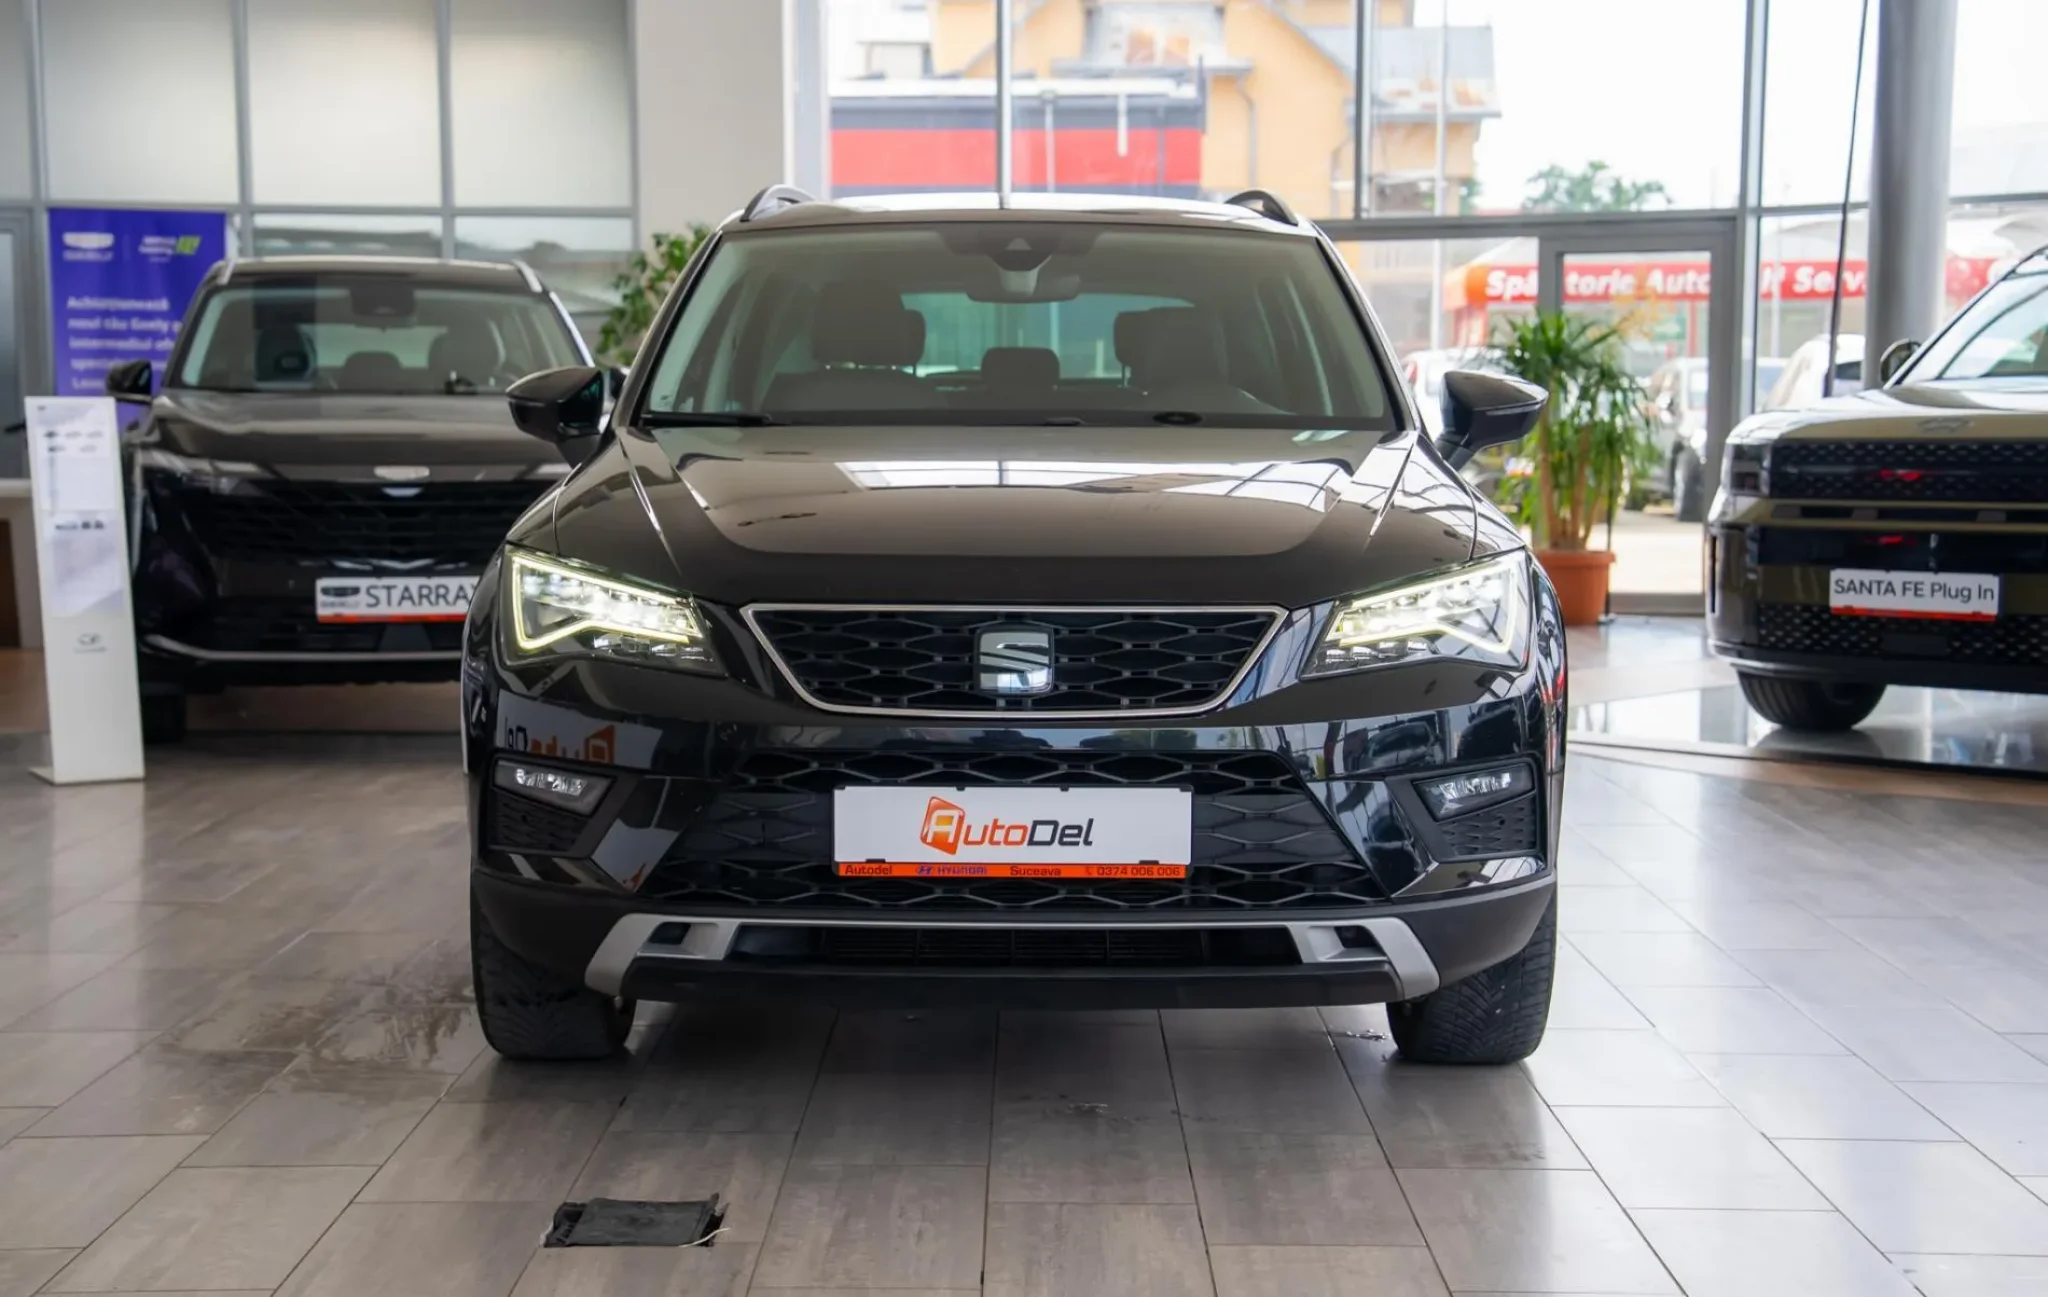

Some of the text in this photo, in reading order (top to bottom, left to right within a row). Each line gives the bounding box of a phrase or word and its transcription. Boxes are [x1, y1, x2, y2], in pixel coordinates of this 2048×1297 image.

[365, 583, 477, 608] STARRA
[1834, 578, 1995, 604] SANTA FE Plug In
[925, 806, 1095, 847] AutoDel
[844, 865, 893, 875] Autodel
[1010, 866, 1062, 877] Suceava
[1096, 866, 1128, 877] 0374
[1131, 866, 1154, 877] 006
[1157, 866, 1181, 877] 006
